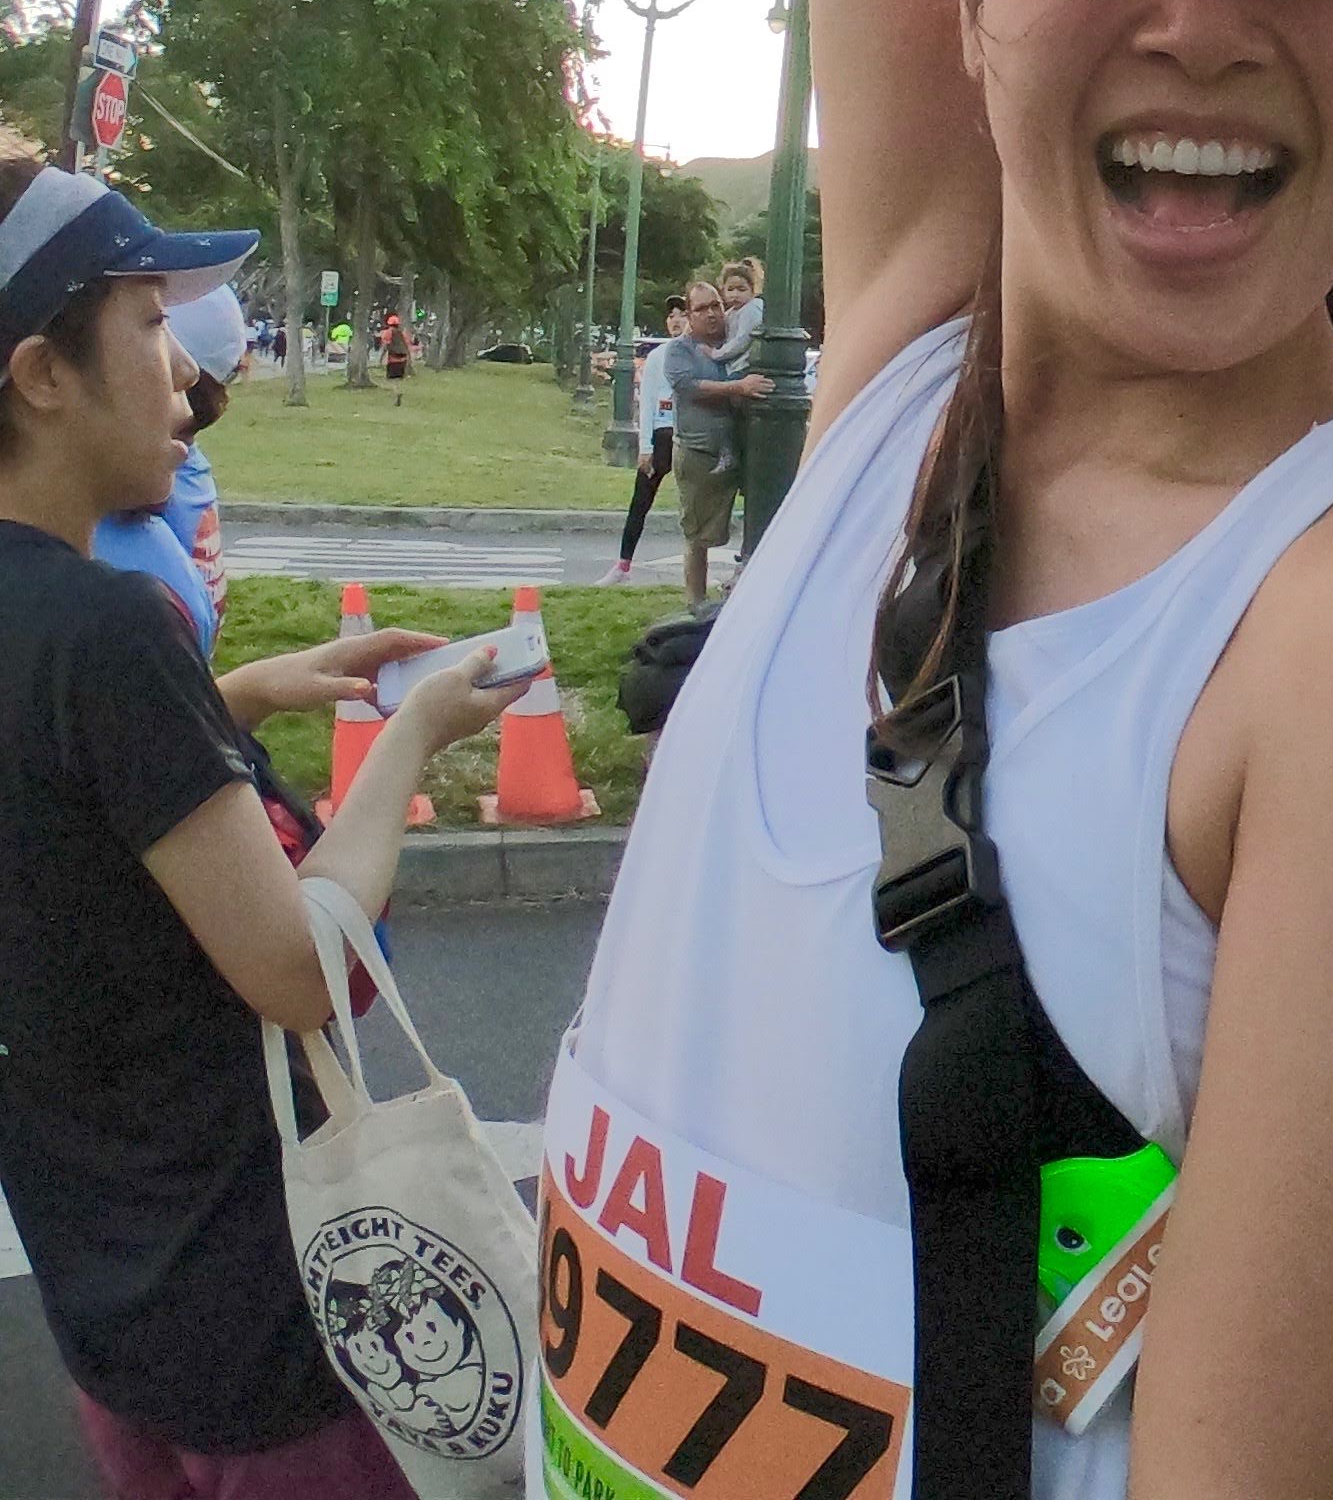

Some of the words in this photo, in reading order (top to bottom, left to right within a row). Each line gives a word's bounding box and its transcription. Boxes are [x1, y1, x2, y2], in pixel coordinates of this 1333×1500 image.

[97, 92, 125, 126] STOP
[565, 1105, 763, 1318] JAL
[466, 1370, 514, 1450] KUKU
